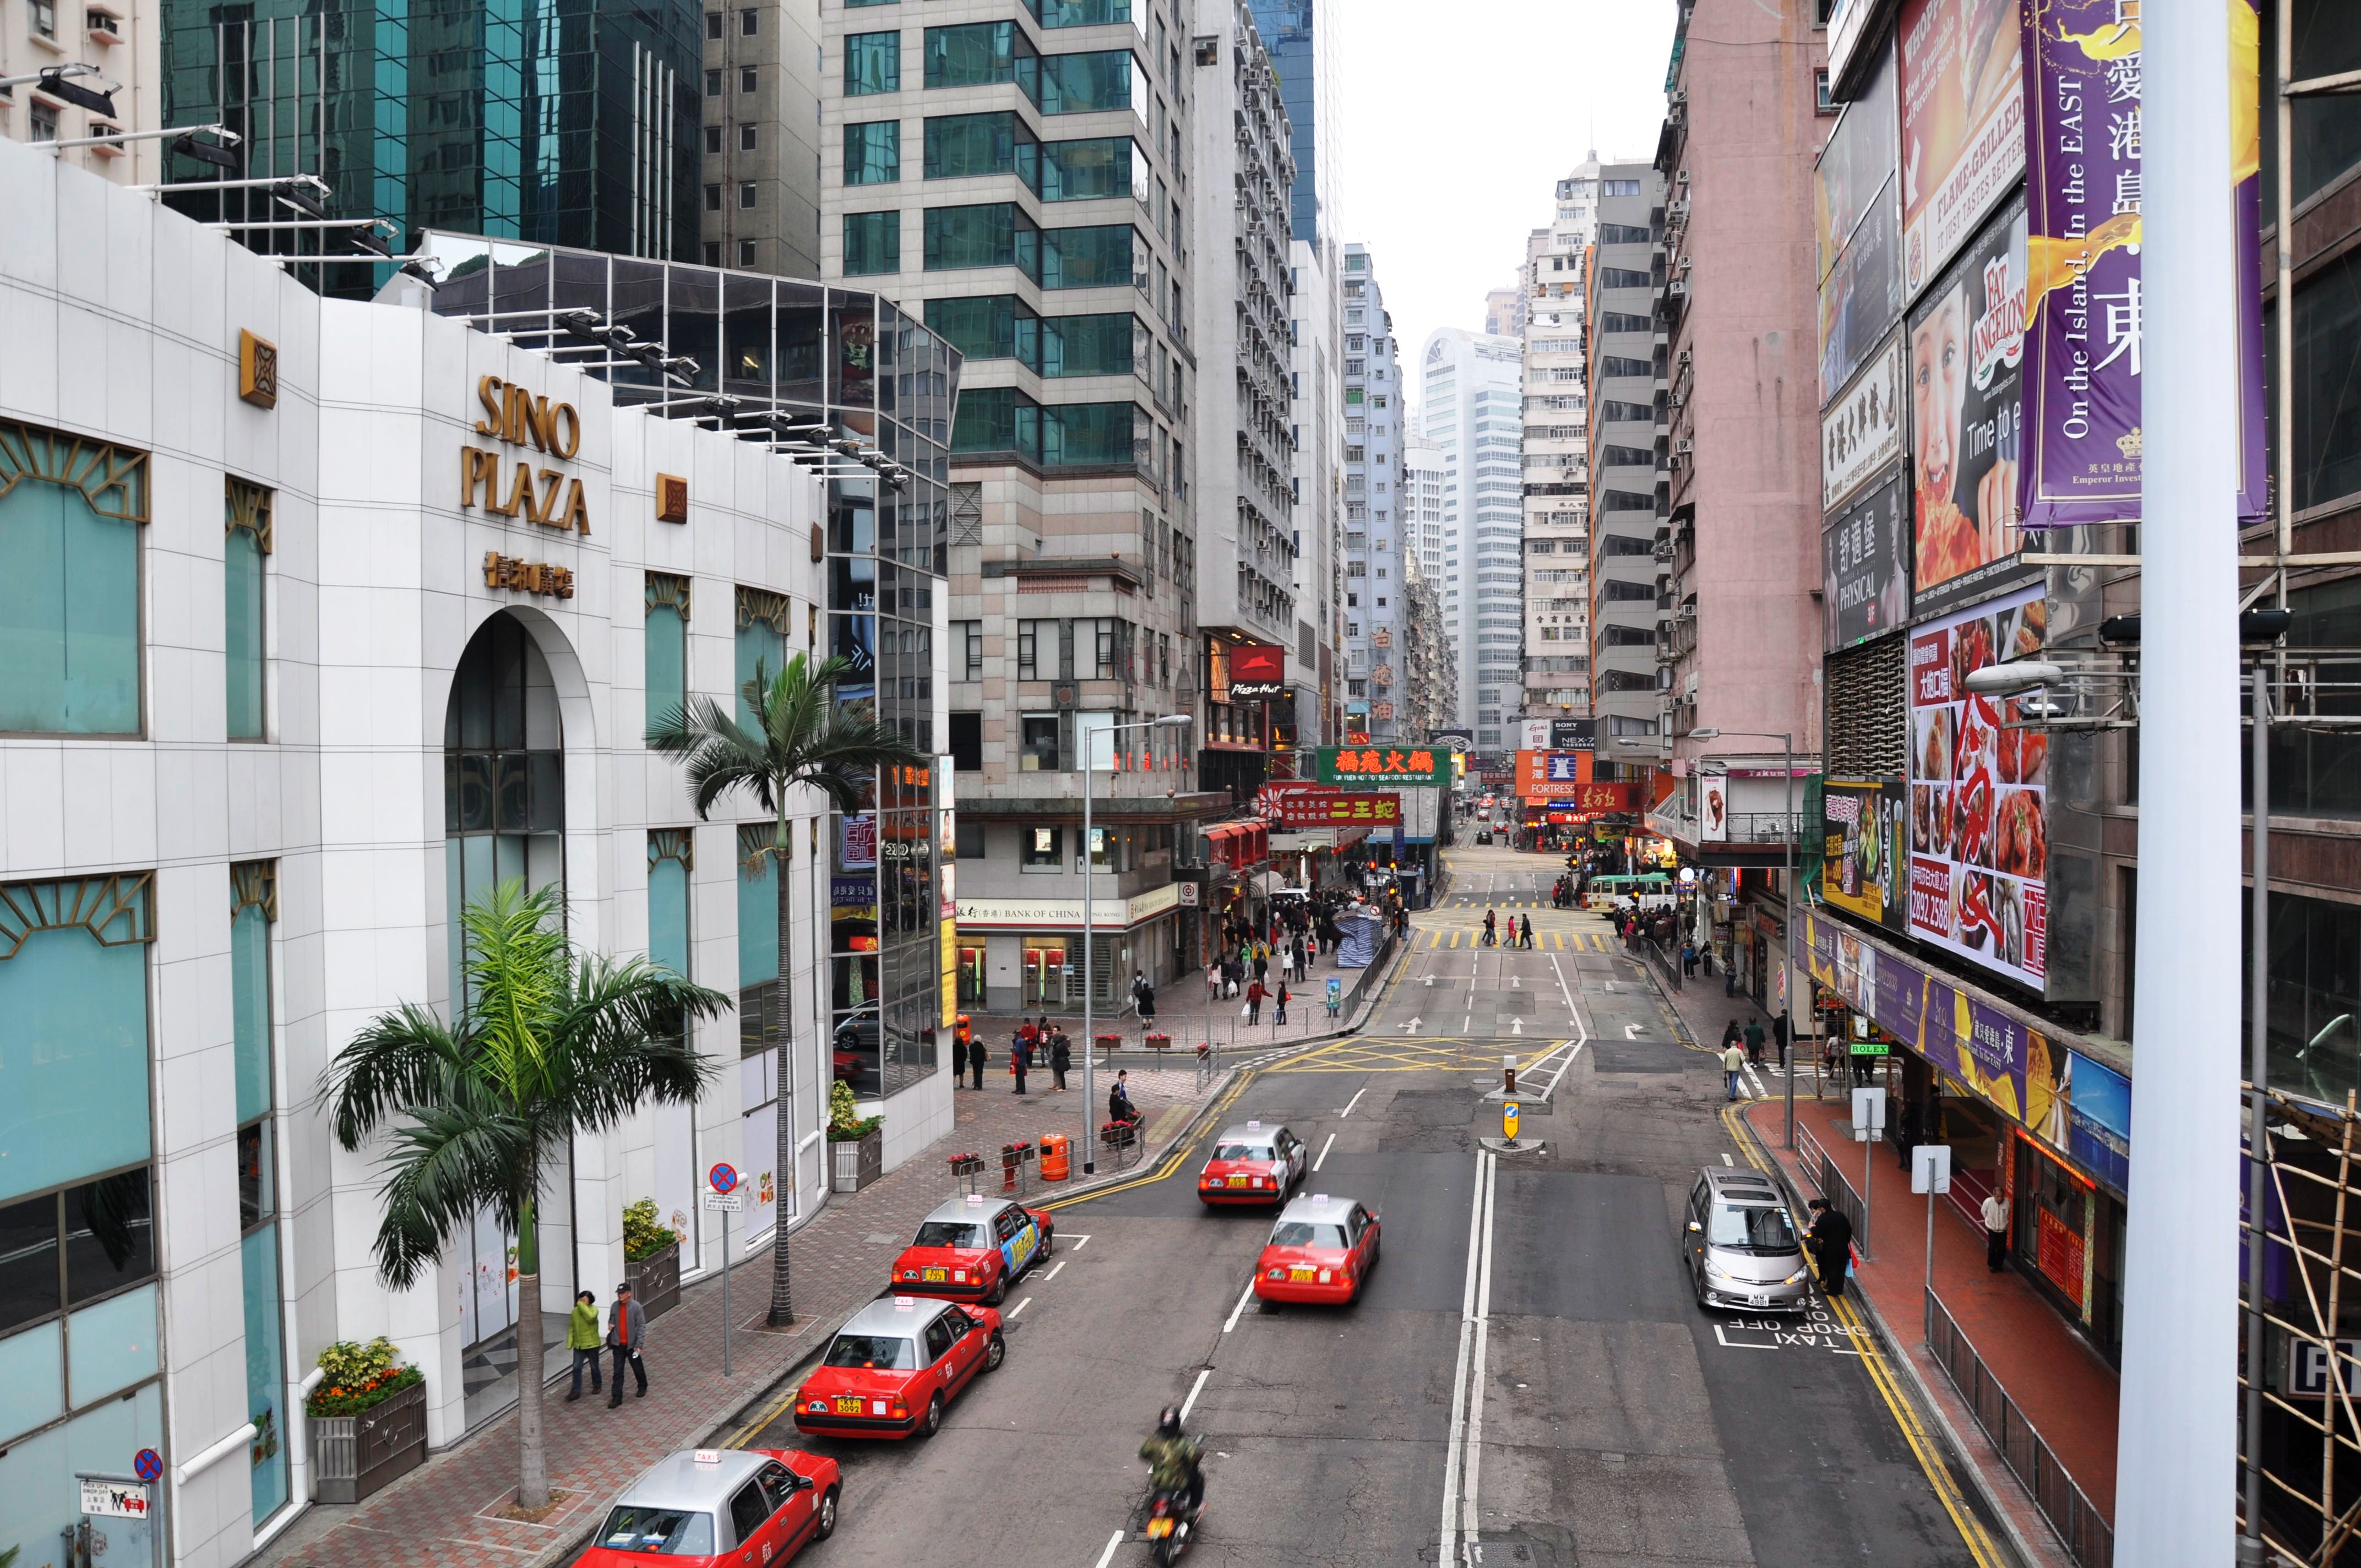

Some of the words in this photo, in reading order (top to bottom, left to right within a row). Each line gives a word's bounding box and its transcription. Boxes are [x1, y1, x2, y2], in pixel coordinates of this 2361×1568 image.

[1906, 77, 1921, 106] Now
[1921, 15, 1954, 77] Available
[1911, 71, 1936, 118] Percival
[1937, 40, 1956, 80] Street
[2058, 75, 2083, 155] EAST
[1938, 95, 2021, 225] FLAME-GRILLED
[2062, 162, 2085, 205] the
[1938, 236, 1944, 253] IT
[1945, 210, 1961, 247] JUST
[1963, 173, 1990, 221] TASTES
[2064, 213, 2086, 242] In
[1987, 264, 2007, 311] FAT
[2064, 251, 2092, 341] Island,
[1973, 288, 2025, 374] ANGELO'S
[2063, 350, 2088, 391] the
[476, 375, 580, 460] SINO
[1967, 419, 1994, 460] Time
[1998, 405, 2010, 441] to
[2063, 400, 2088, 439] On
[461, 445, 592, 536] PLAZA
[2072, 475, 2112, 485] Emperor
[2114, 474, 2141, 484] Invest
[484, 551, 574, 599] 信和廣場
[1840, 571, 1876, 612] PHYSICAL
[1231, 683, 1259, 695] Pizza
[1259, 683, 1282, 694] Hut
[1336, 750, 1433, 773] 福苑火鍋
[1531, 784, 1575, 793] FORTRESS
[1883, 798, 1891, 907] Carlsberg
[1005, 910, 1031, 918] BANK
[1033, 910, 1046, 918] OF
[1049, 910, 1080, 918] CHINA
[1912, 889, 1928, 923] 2892
[1930, 895, 1949, 930] 2588
[1990, 1054, 2001, 1070] EAST
[1728, 1318, 1781, 1331] OFF
[1775, 1332, 1840, 1347] TAXI
[1796, 1322, 1870, 1337] DROP
[2305, 1347, 2341, 1387] P
